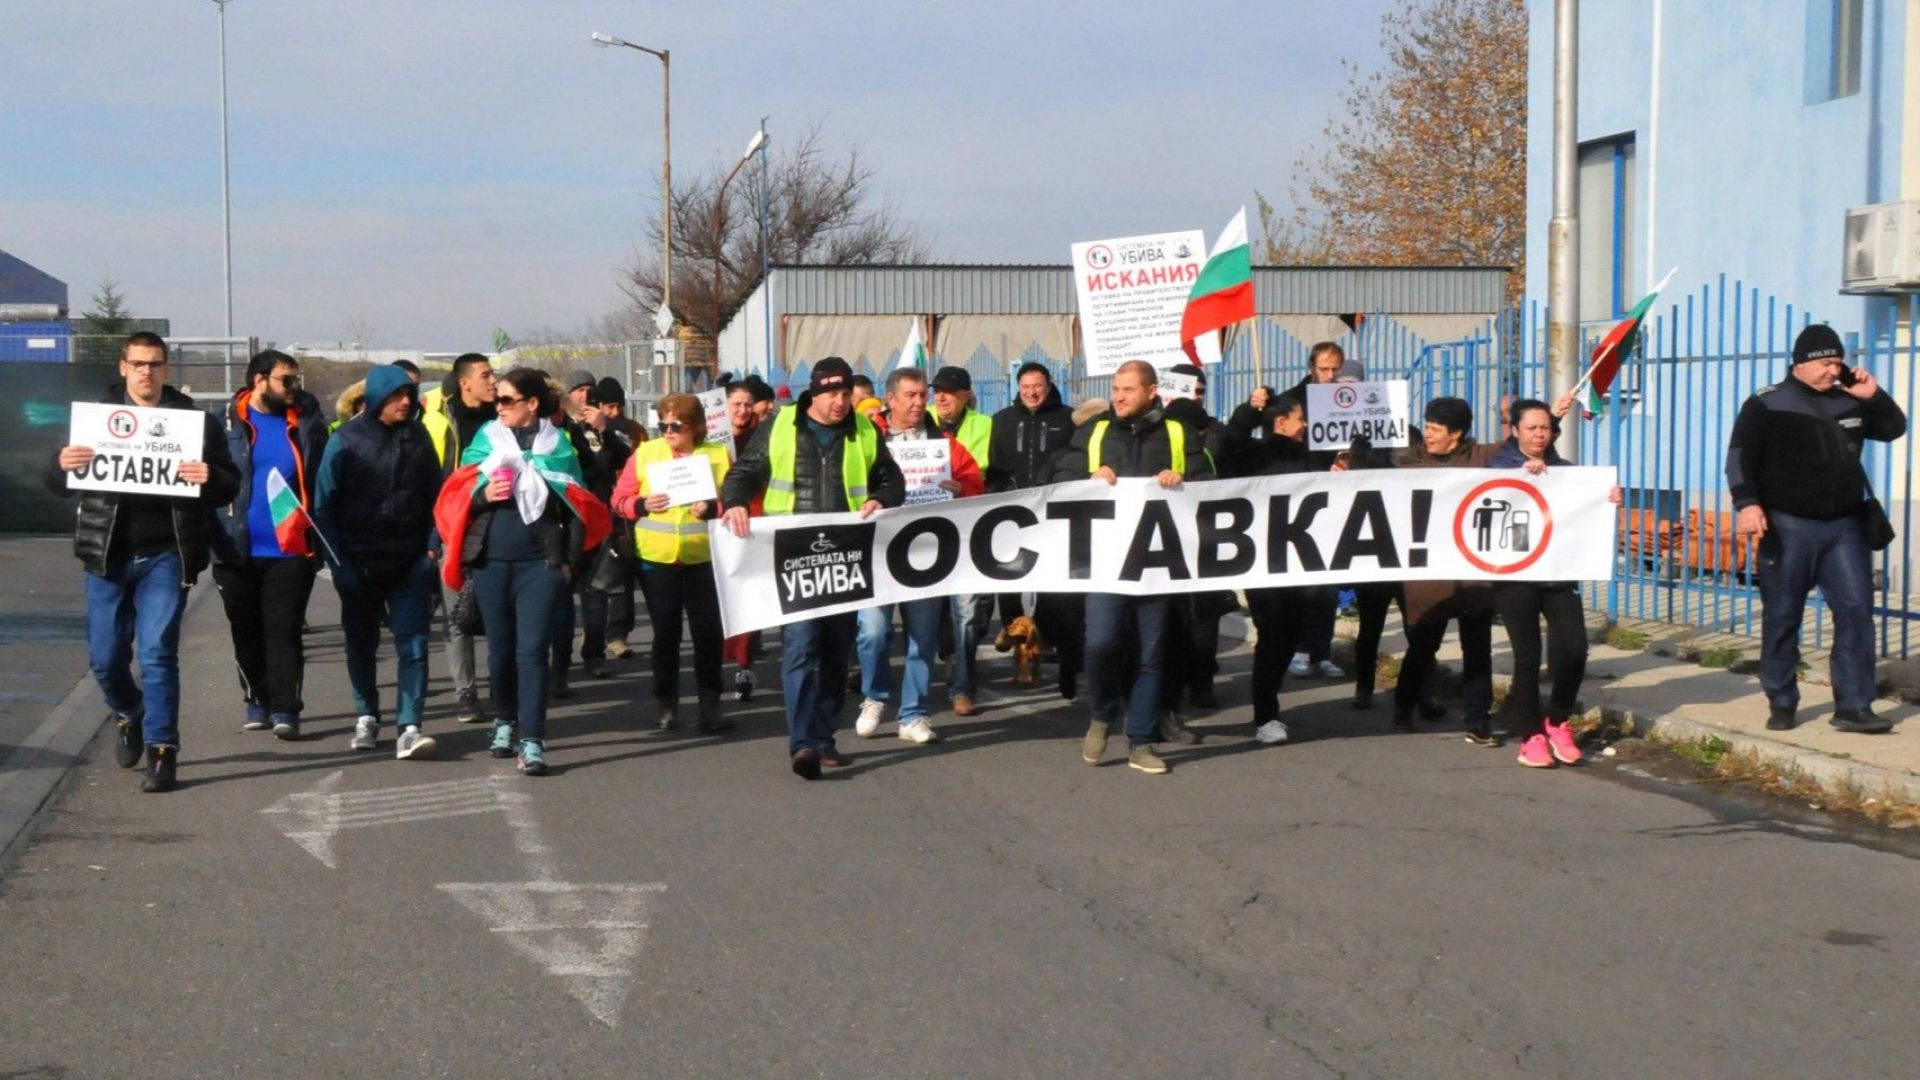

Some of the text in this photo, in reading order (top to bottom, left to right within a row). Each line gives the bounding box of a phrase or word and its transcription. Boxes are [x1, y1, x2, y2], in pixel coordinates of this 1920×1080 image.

[1120, 248, 1165, 265] УБИВА
[1087, 263, 1199, 291] ИСКАНИЯ
[1807, 349, 1837, 359] POLICE
[1312, 418, 1405, 443] ОСТАВКА!
[144, 441, 182, 453] УБИВА
[73, 454, 197, 487] ОСТАВК
[886, 489, 1433, 588] ОСТАВКА!
[783, 550, 862, 571] СИСТЕМАТА НИ
[781, 562, 867, 602] УБИВА
